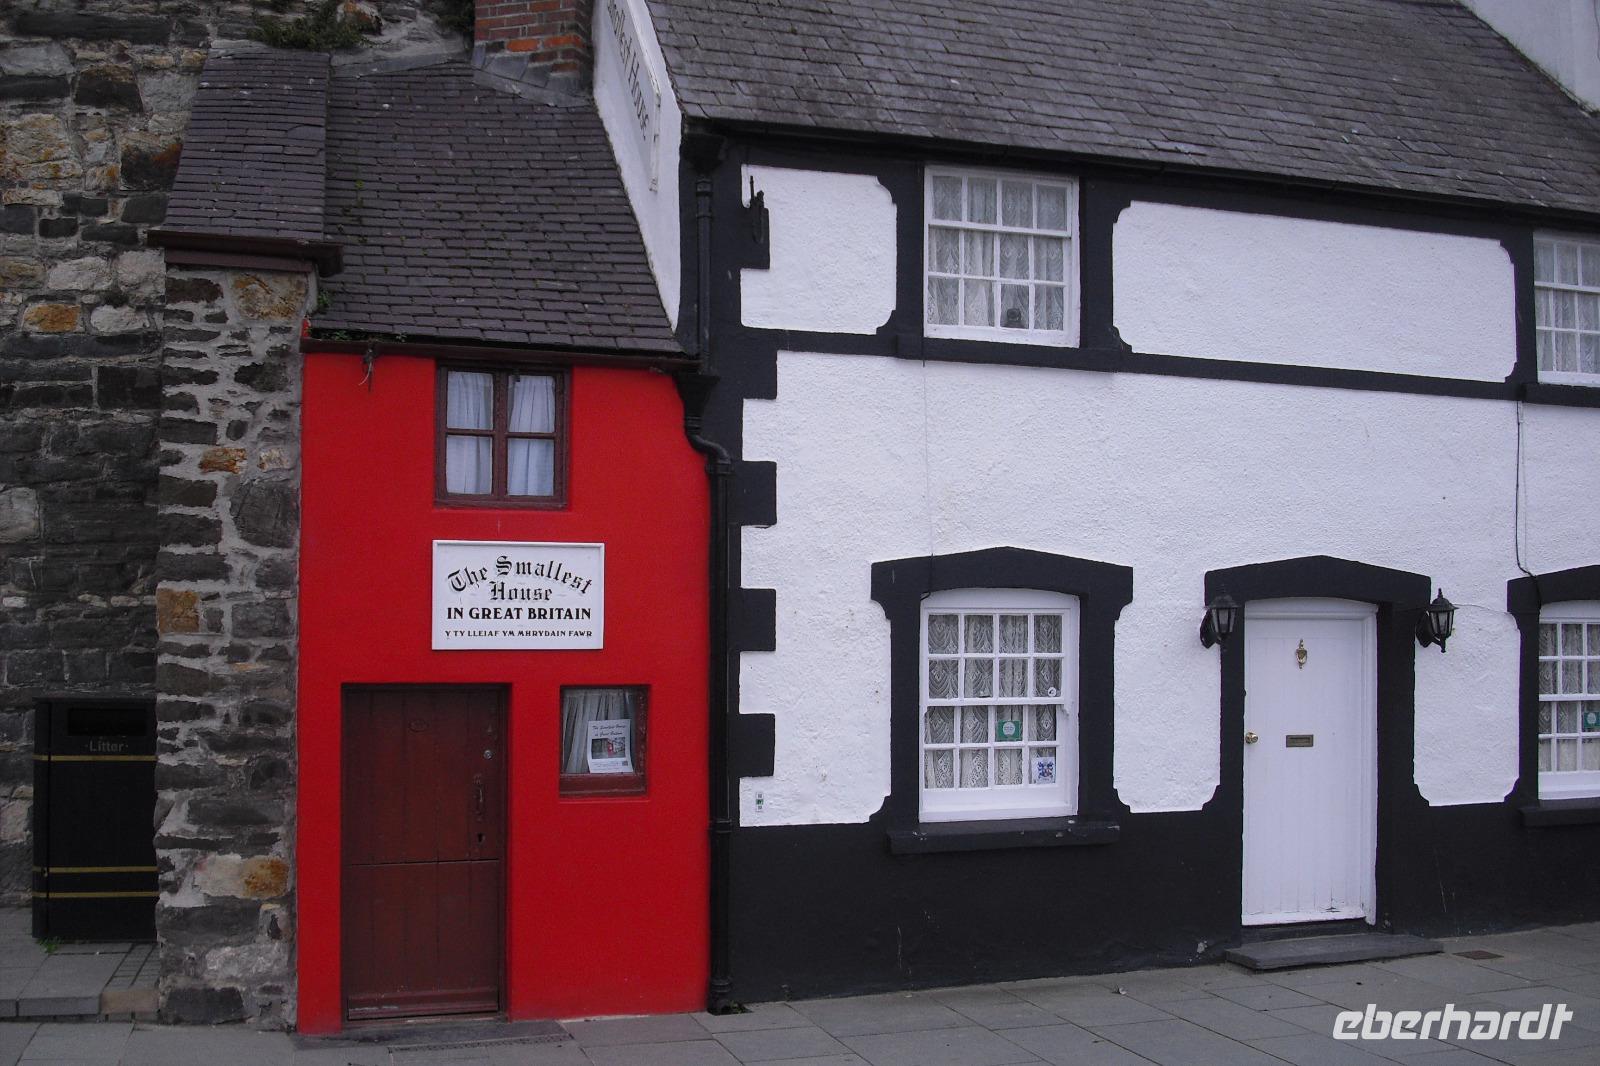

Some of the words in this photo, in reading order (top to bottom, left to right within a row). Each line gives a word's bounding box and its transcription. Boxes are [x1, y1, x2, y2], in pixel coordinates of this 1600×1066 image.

[447, 565, 488, 592] The
[495, 555, 593, 594] Smallest
[489, 580, 553, 601] House
[447, 607, 464, 620] IN
[469, 607, 523, 620] GREAT
[527, 607, 591, 620] BRITAIN
